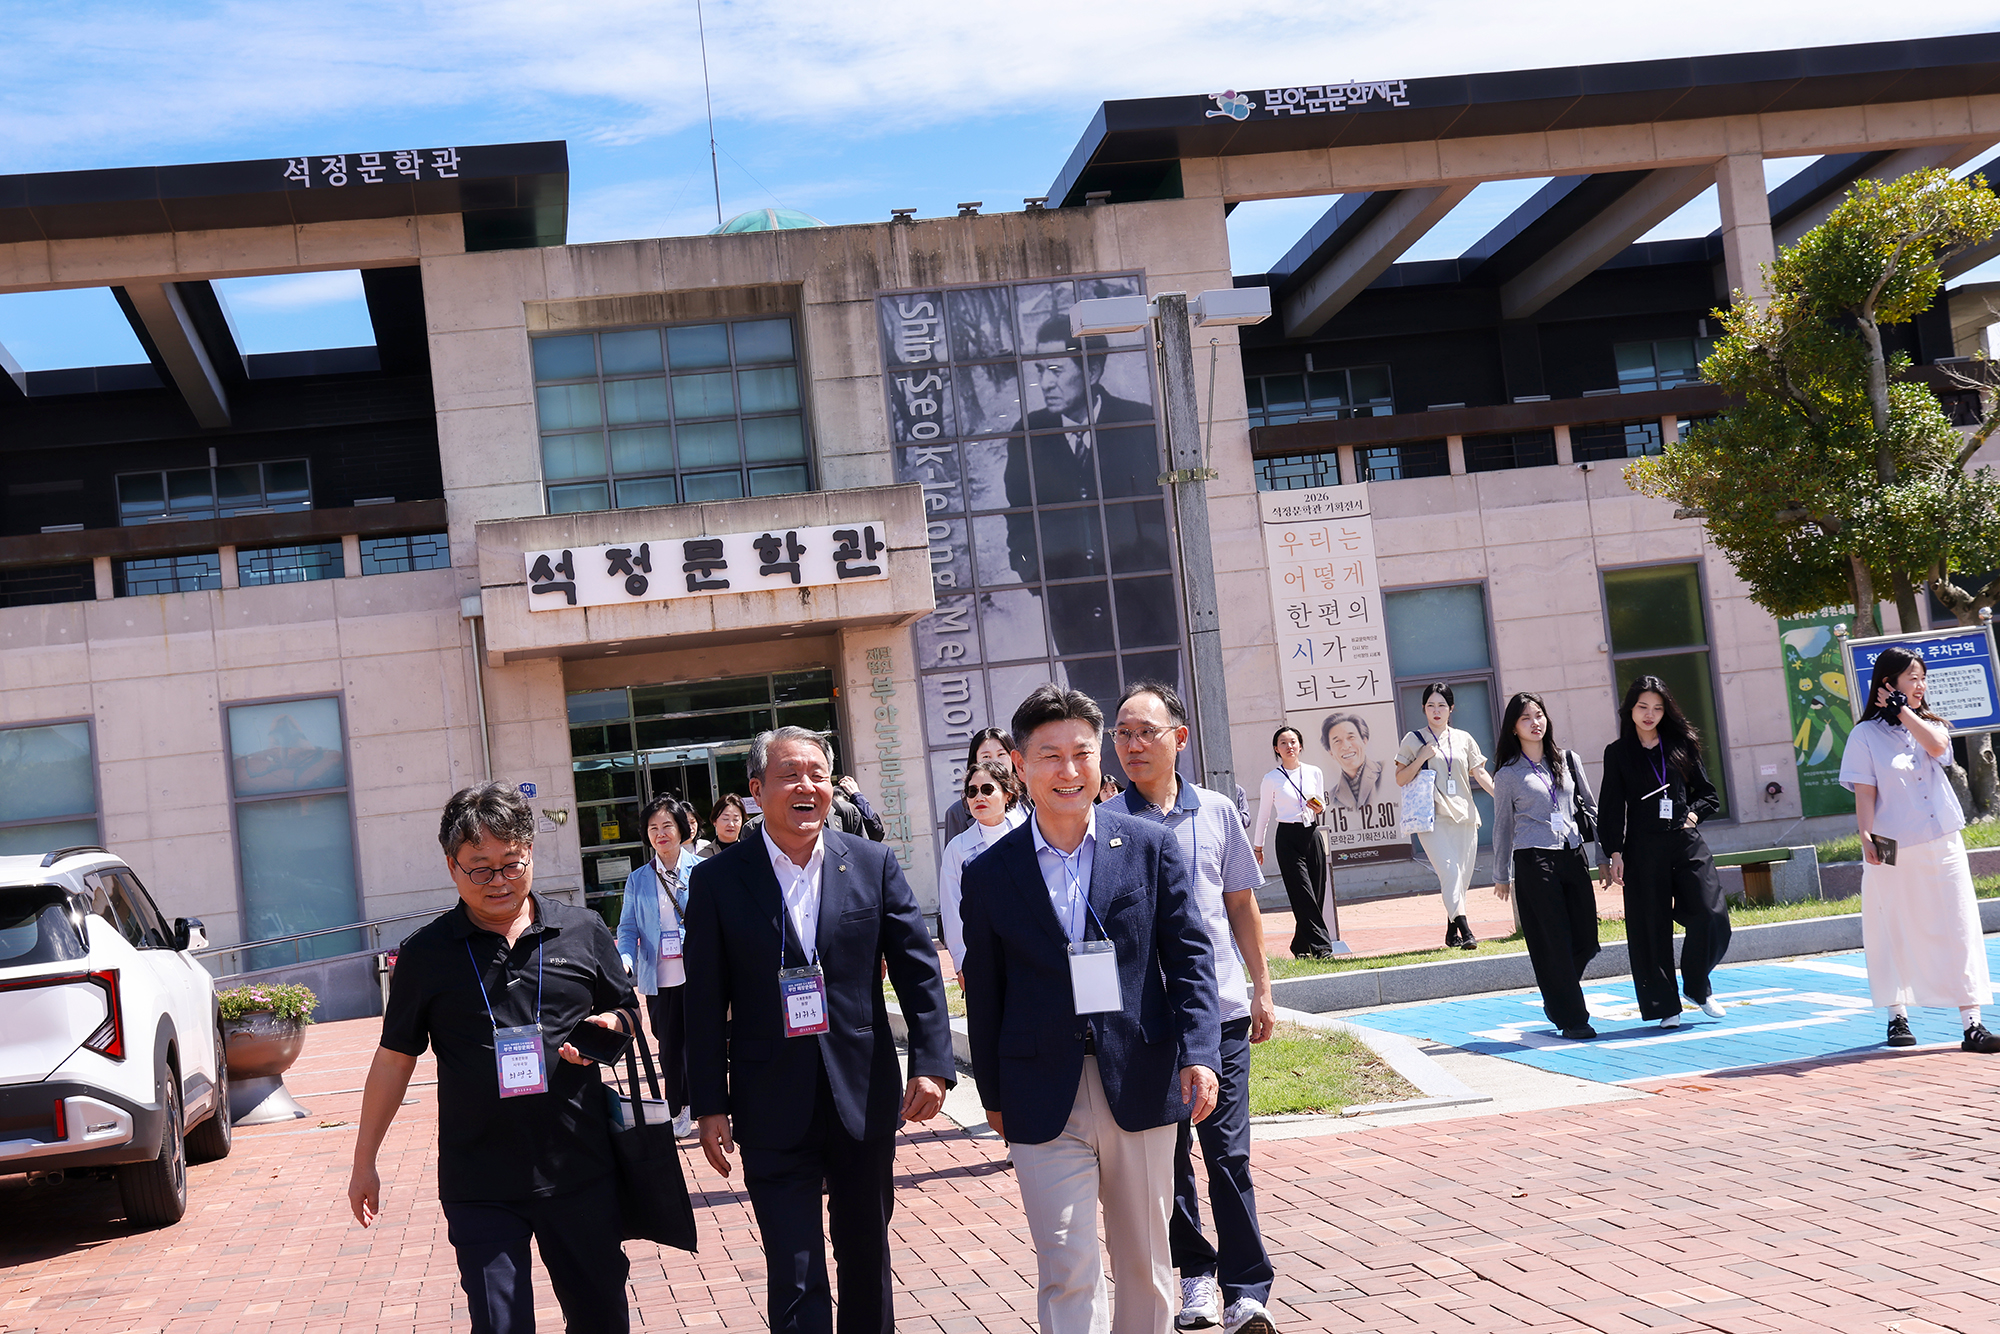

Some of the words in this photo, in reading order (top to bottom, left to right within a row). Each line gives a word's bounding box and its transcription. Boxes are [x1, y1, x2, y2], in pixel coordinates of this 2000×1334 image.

[1264, 78, 1410, 117] 부안군문화재단
[283, 147, 461, 188] 석정문학관
[899, 301, 939, 363] Shin
[1272, 503, 1322, 518] 석정문학관
[1325, 499, 1363, 513] 기획전시
[1303, 492, 1329, 503] 2026
[1278, 526, 1362, 557] 우리는
[528, 525, 885, 606] 석정문학관
[1284, 560, 1365, 593] 어떻게
[1292, 635, 1347, 666] 시가
[1928, 642, 1976, 658] 주차구역
[1296, 669, 1380, 702] 되는가
[1358, 802, 1395, 830] 12.30
[1357, 830, 1397, 843] 기획전시실
